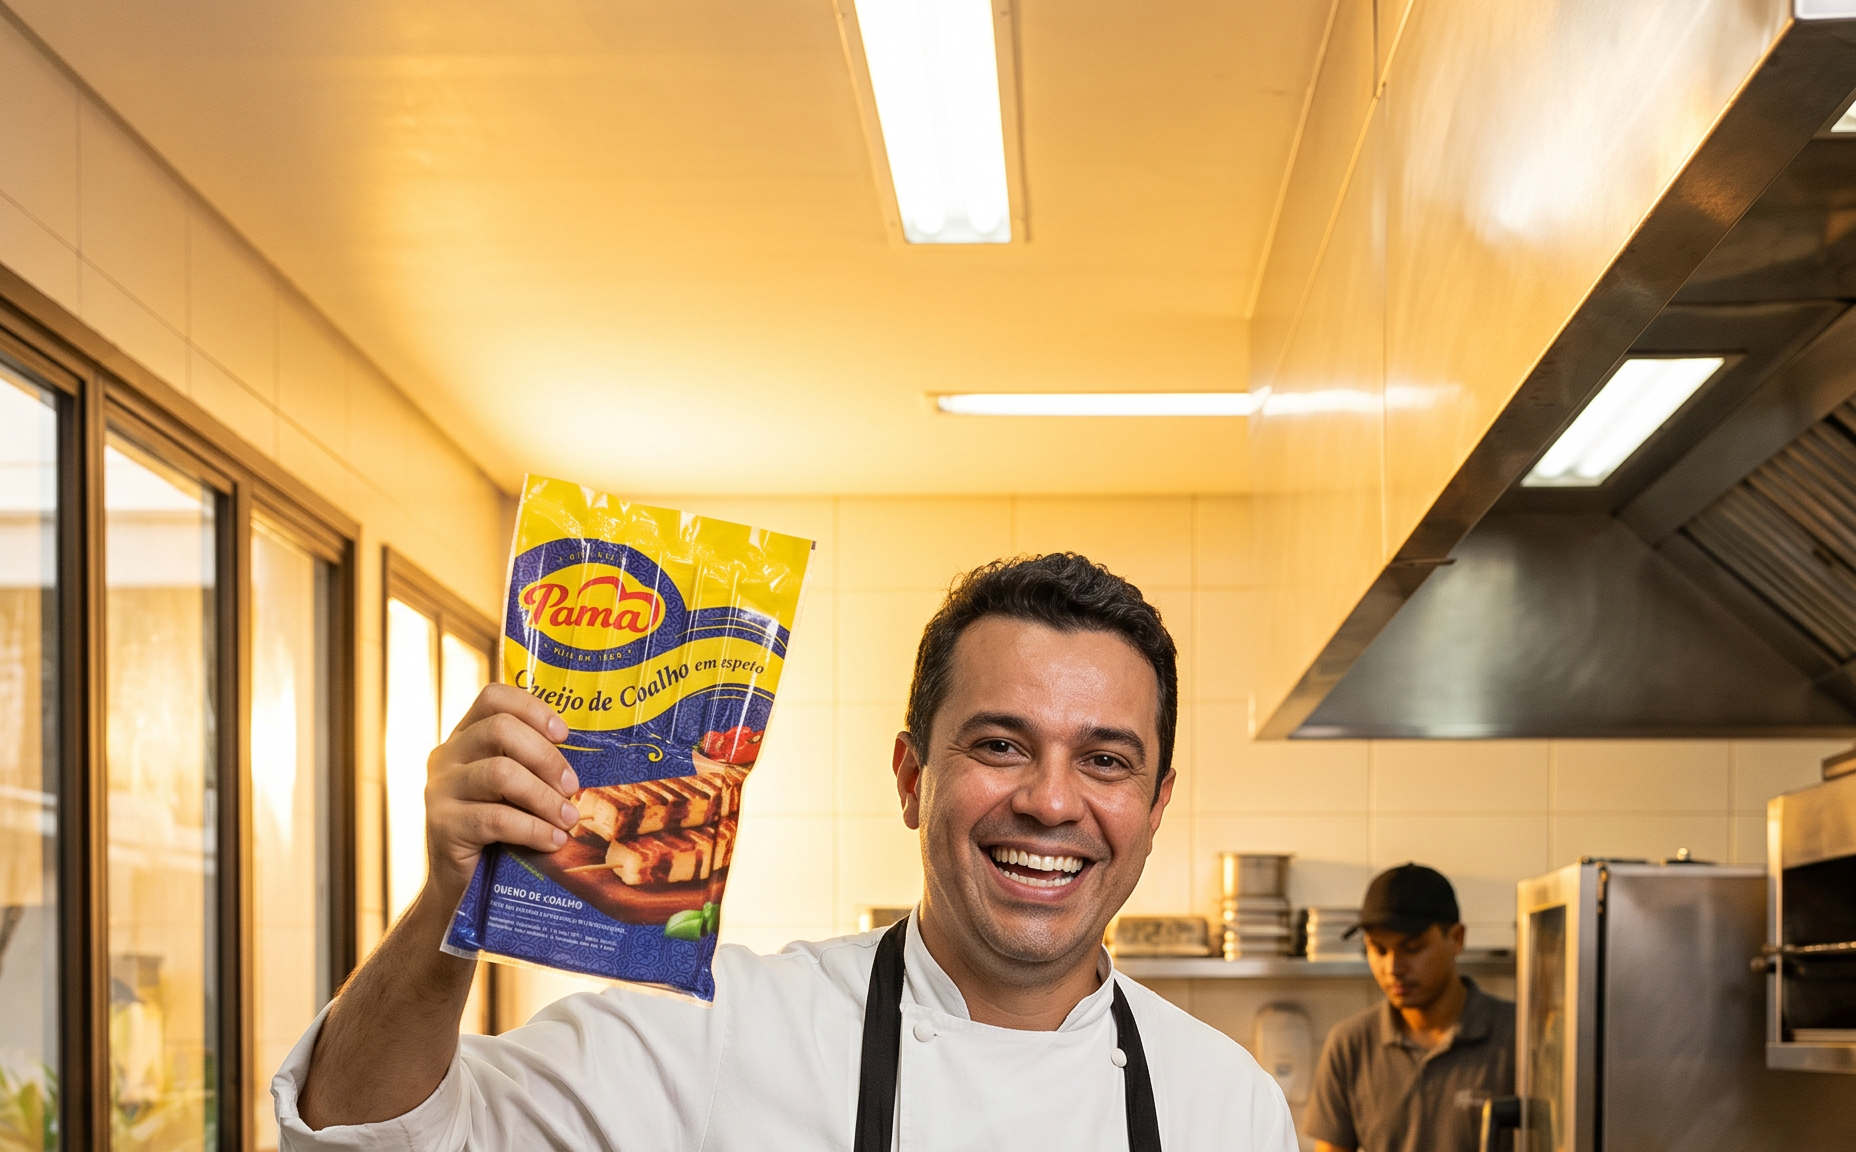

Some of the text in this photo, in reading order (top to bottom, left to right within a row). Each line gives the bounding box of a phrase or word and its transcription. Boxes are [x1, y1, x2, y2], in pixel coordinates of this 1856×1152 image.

[523, 575, 661, 633] Pama
[588, 690, 613, 712] de
[619, 663, 690, 708] Coalho
[694, 658, 717, 672] em
[720, 657, 765, 675] espeto
[528, 891, 542, 902] DE
